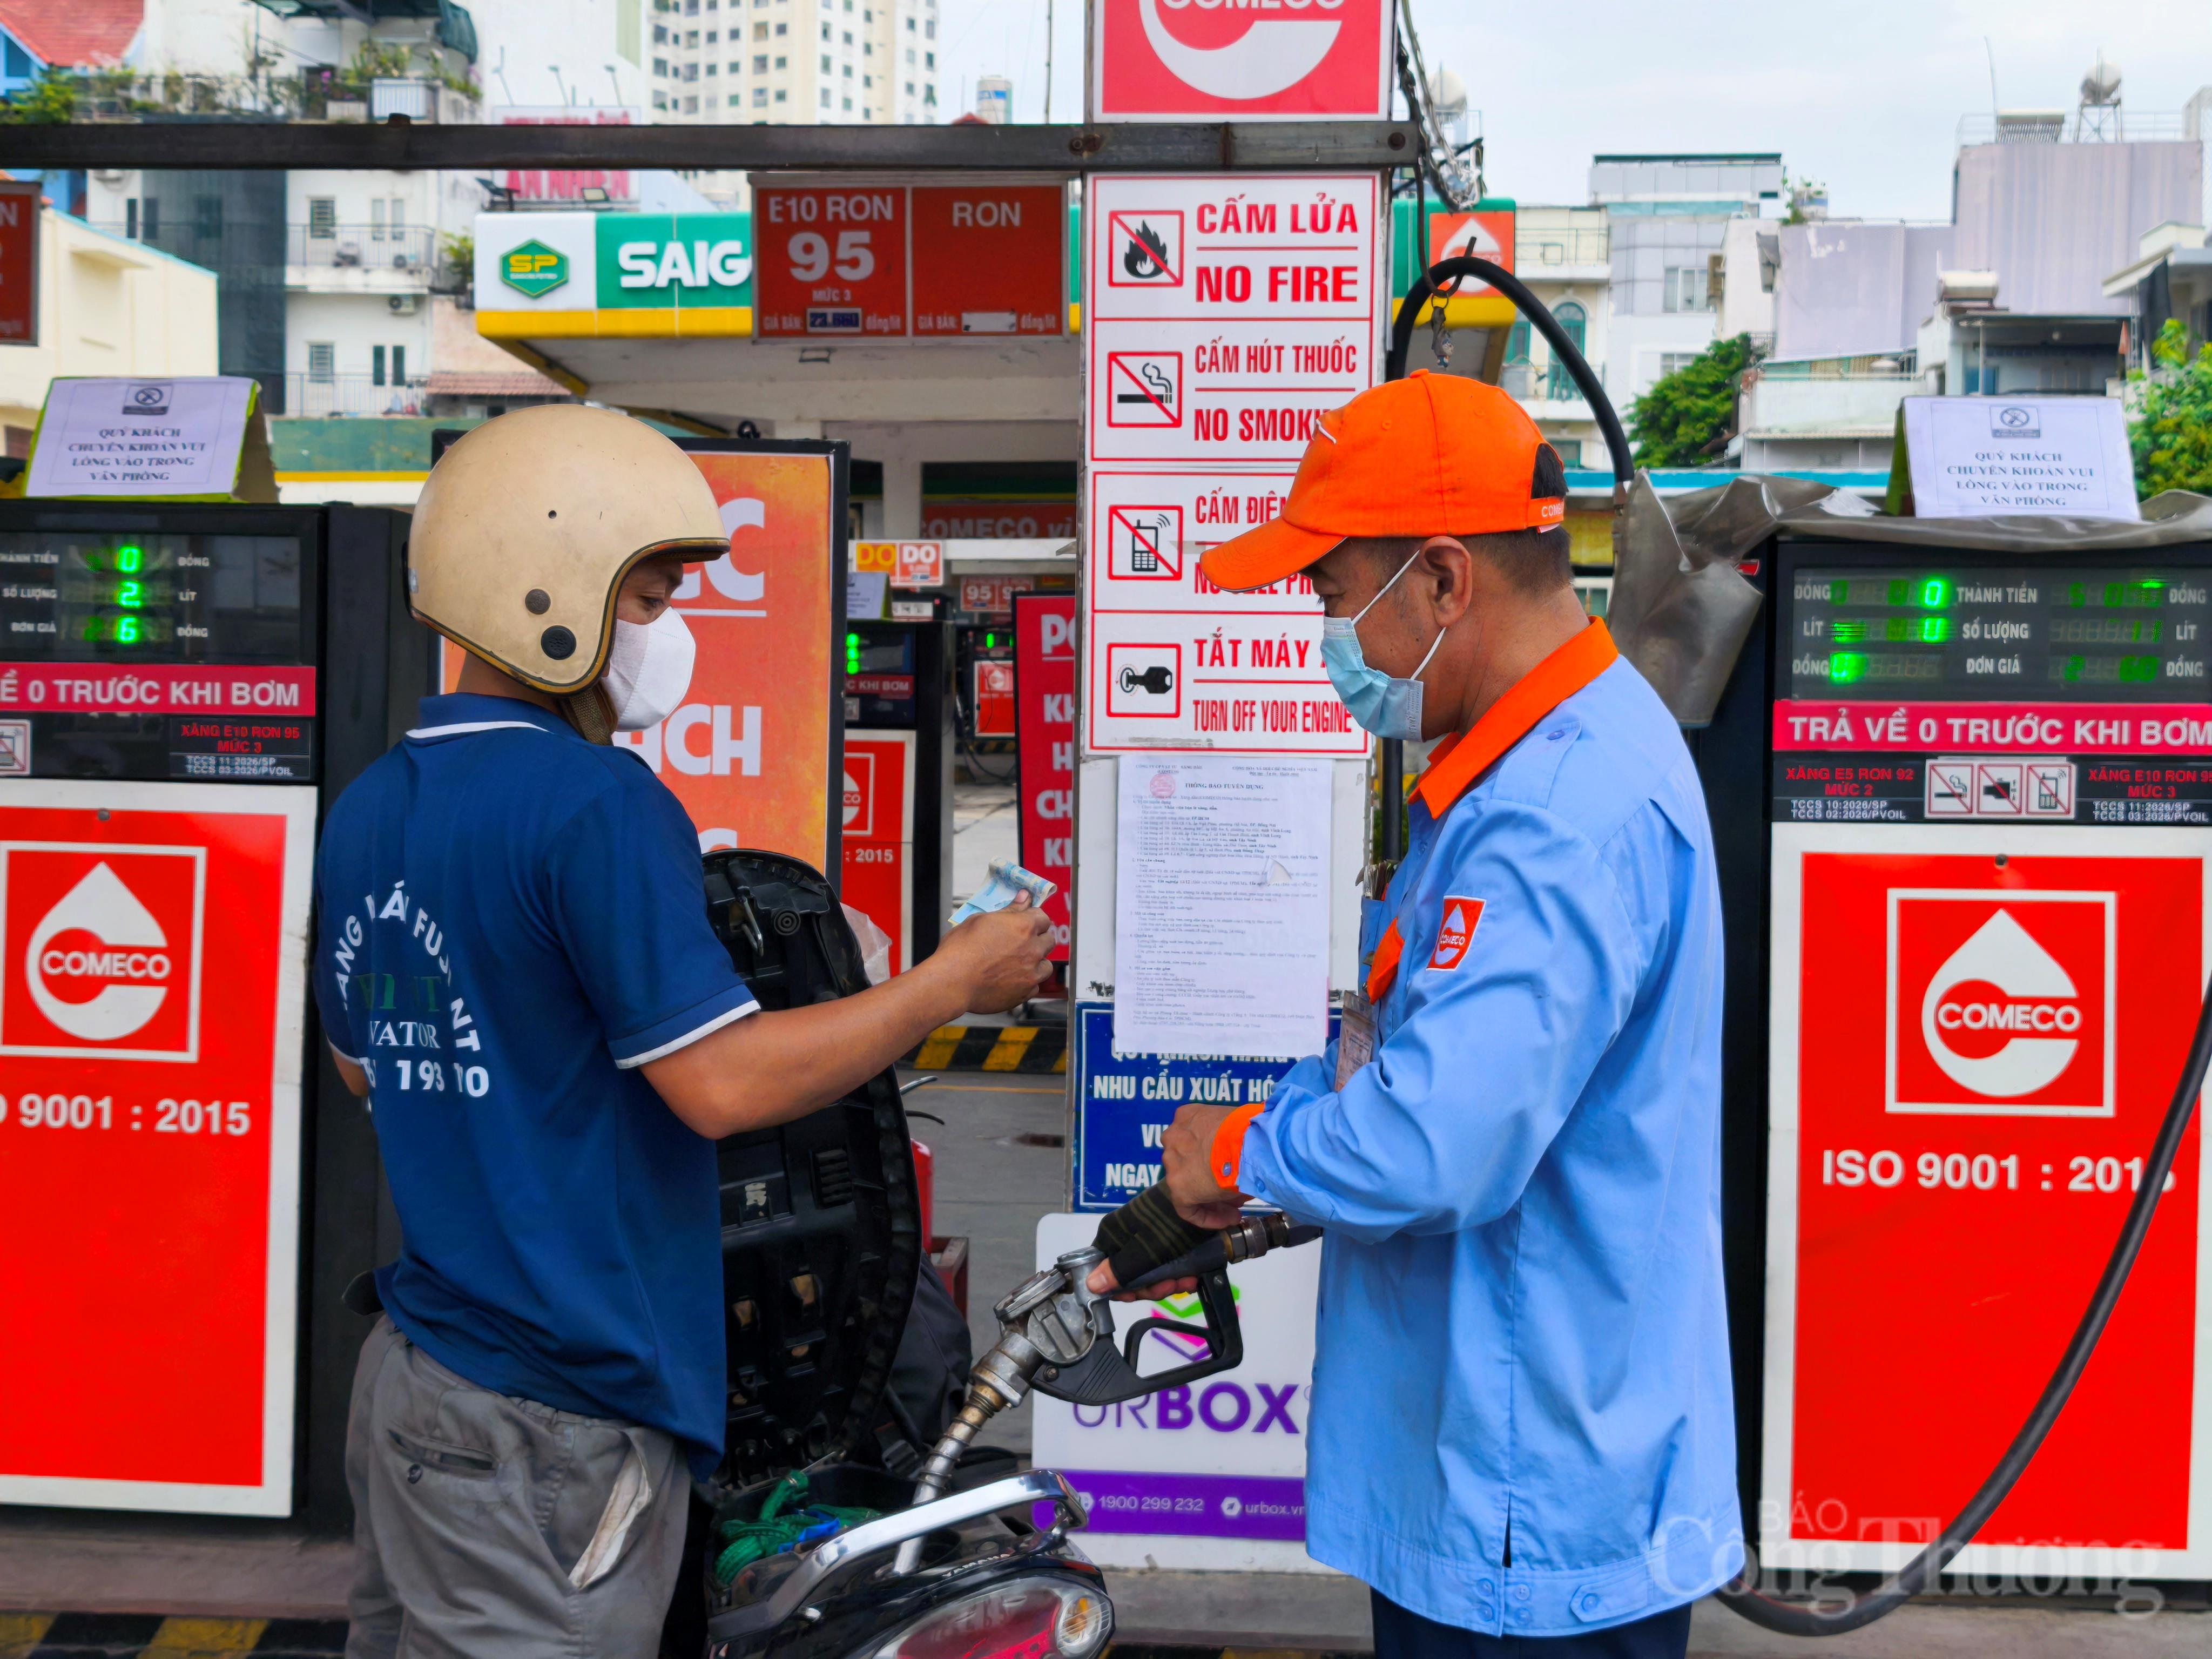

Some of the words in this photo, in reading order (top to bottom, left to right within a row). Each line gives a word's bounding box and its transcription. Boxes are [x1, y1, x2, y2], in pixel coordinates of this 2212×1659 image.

[768, 197, 818, 222] E10
[826, 194, 893, 221] RON
[952, 201, 1022, 228] RON
[1196, 193, 1277, 234] CẤM
[1290, 192, 1358, 234] LỬA
[509, 255, 558, 273] SP
[787, 230, 875, 282] 95
[844, 289, 852, 301] 3
[1195, 266, 1251, 302] NO
[1268, 266, 1358, 302] FIRE
[1195, 335, 1239, 373] CẤM
[1246, 338, 1285, 373] HÚT
[1292, 335, 1357, 373] THUỐC
[1194, 408, 1229, 441] NO
[1238, 408, 1330, 442] SMOK
[1195, 487, 1239, 524] CẤM
[902, 545, 936, 564] DO
[966, 585, 992, 601] 95
[1957, 582, 2001, 603] THÀNH
[2006, 581, 2038, 603] TIỀN
[1803, 616, 1823, 636] LÍT
[1963, 616, 1980, 639] SỐ
[2176, 620, 2197, 640] LÍT
[1193, 626, 1242, 667] TẮT
[1251, 632, 1310, 668] MÁY
[1966, 657, 1994, 674] ĐƠN
[1998, 653, 2021, 674] GIÁ
[28, 680, 46, 704] 0
[52, 675, 161, 705] TRƯỚC
[170, 682, 221, 705] KHI
[232, 680, 300, 706] BƠM
[1193, 700, 1228, 731] TURN
[1232, 700, 1256, 732] OFF
[1261, 700, 1297, 732] YOUR
[1302, 700, 1352, 733] ENGINE
[1788, 710, 1854, 742] TRẢ
[1865, 707, 1910, 743] VỀ
[1919, 717, 1937, 743] 0
[1947, 713, 2063, 745] TRƯỚC
[2074, 720, 2129, 745] KHI
[2140, 718, 2212, 746] BƠM
[252, 726, 281, 738] RON
[284, 727, 300, 739] 95
[253, 742, 262, 753] 3
[1785, 765, 1830, 781] XĂNG
[1835, 768, 1853, 781] E5
[1858, 768, 1893, 781] RON
[1896, 768, 1915, 781] 92
[2088, 766, 2131, 782] XĂNG
[2135, 770, 2160, 783] E10
[2165, 770, 2197, 783] RON
[1864, 784, 1874, 797] 2
[2128, 784, 2162, 798] MỨC
[2167, 785, 2177, 798] 3
[855, 849, 894, 864] 2015
[42, 950, 171, 979] COMECO
[1938, 1002, 2081, 1032] COMECO
[1094, 1075, 1136, 1100] NHU
[1189, 1070, 1242, 1102] XUẤT
[19, 1094, 112, 1129] 9001
[154, 1100, 252, 1136] 2015
[1105, 1163, 1162, 1188] NGAY
[1823, 1150, 1904, 1188] ISO
[1917, 1152, 2019, 1190] 9001
[1098, 1496, 1138, 1510] 1900
[1141, 1497, 1172, 1511] 299
[1175, 1498, 1205, 1512] 232
